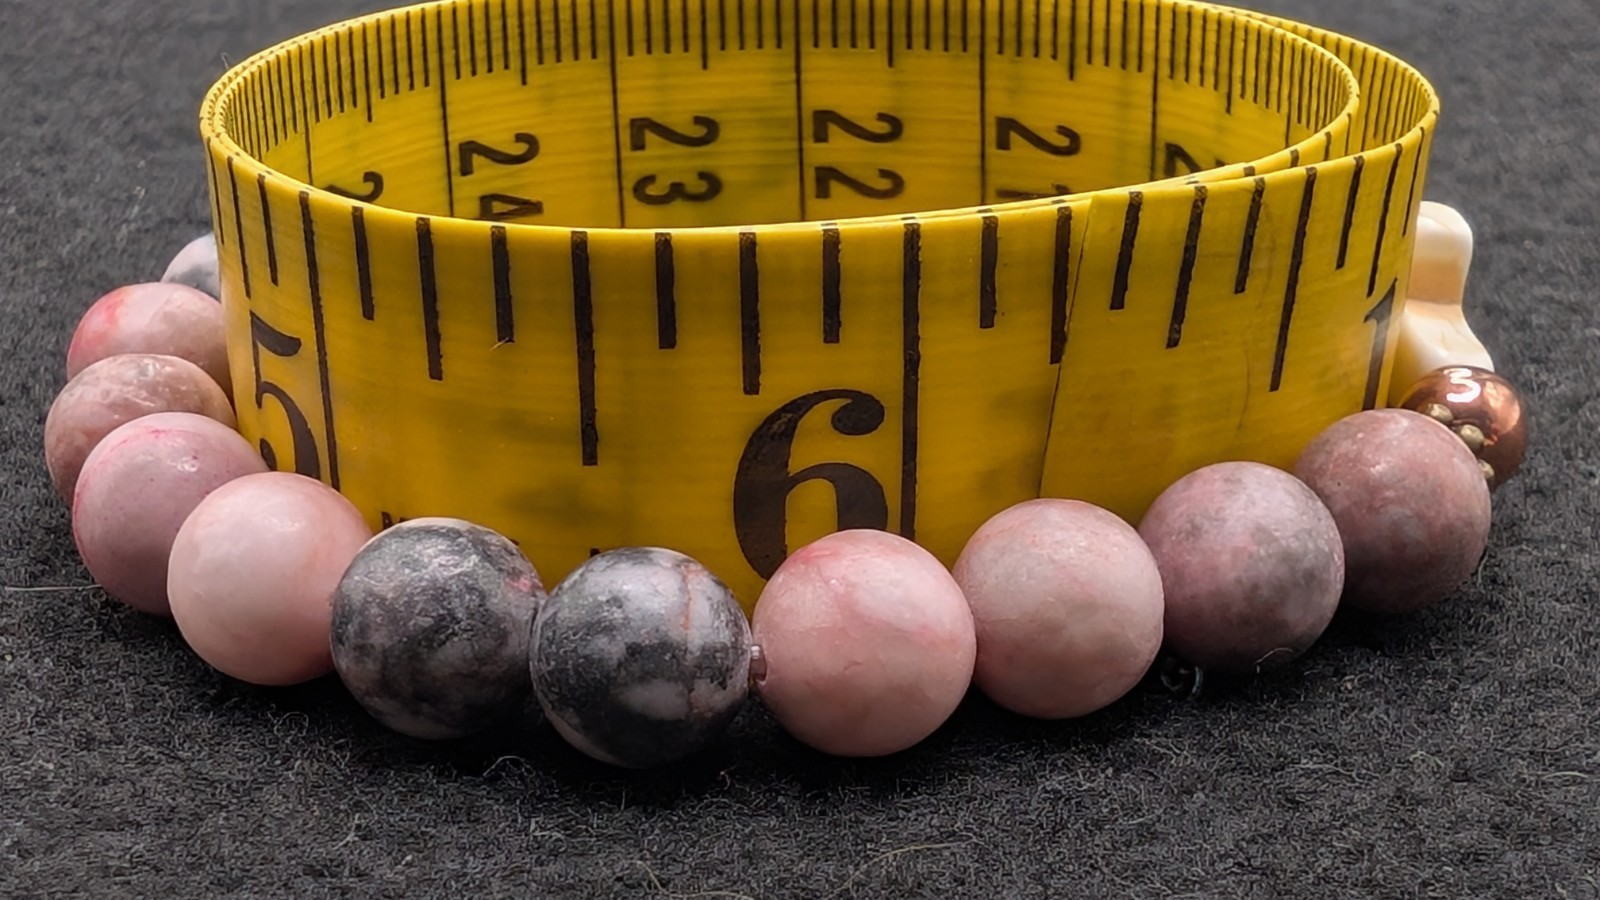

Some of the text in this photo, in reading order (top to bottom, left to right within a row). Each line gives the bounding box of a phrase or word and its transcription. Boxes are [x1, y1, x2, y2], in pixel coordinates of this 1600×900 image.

[630, 115, 722, 206] 23
[812, 109, 904, 198] 22
[249, 310, 321, 481] 5
[1361, 276, 1398, 411] 1
[733, 389, 888, 581] 6
